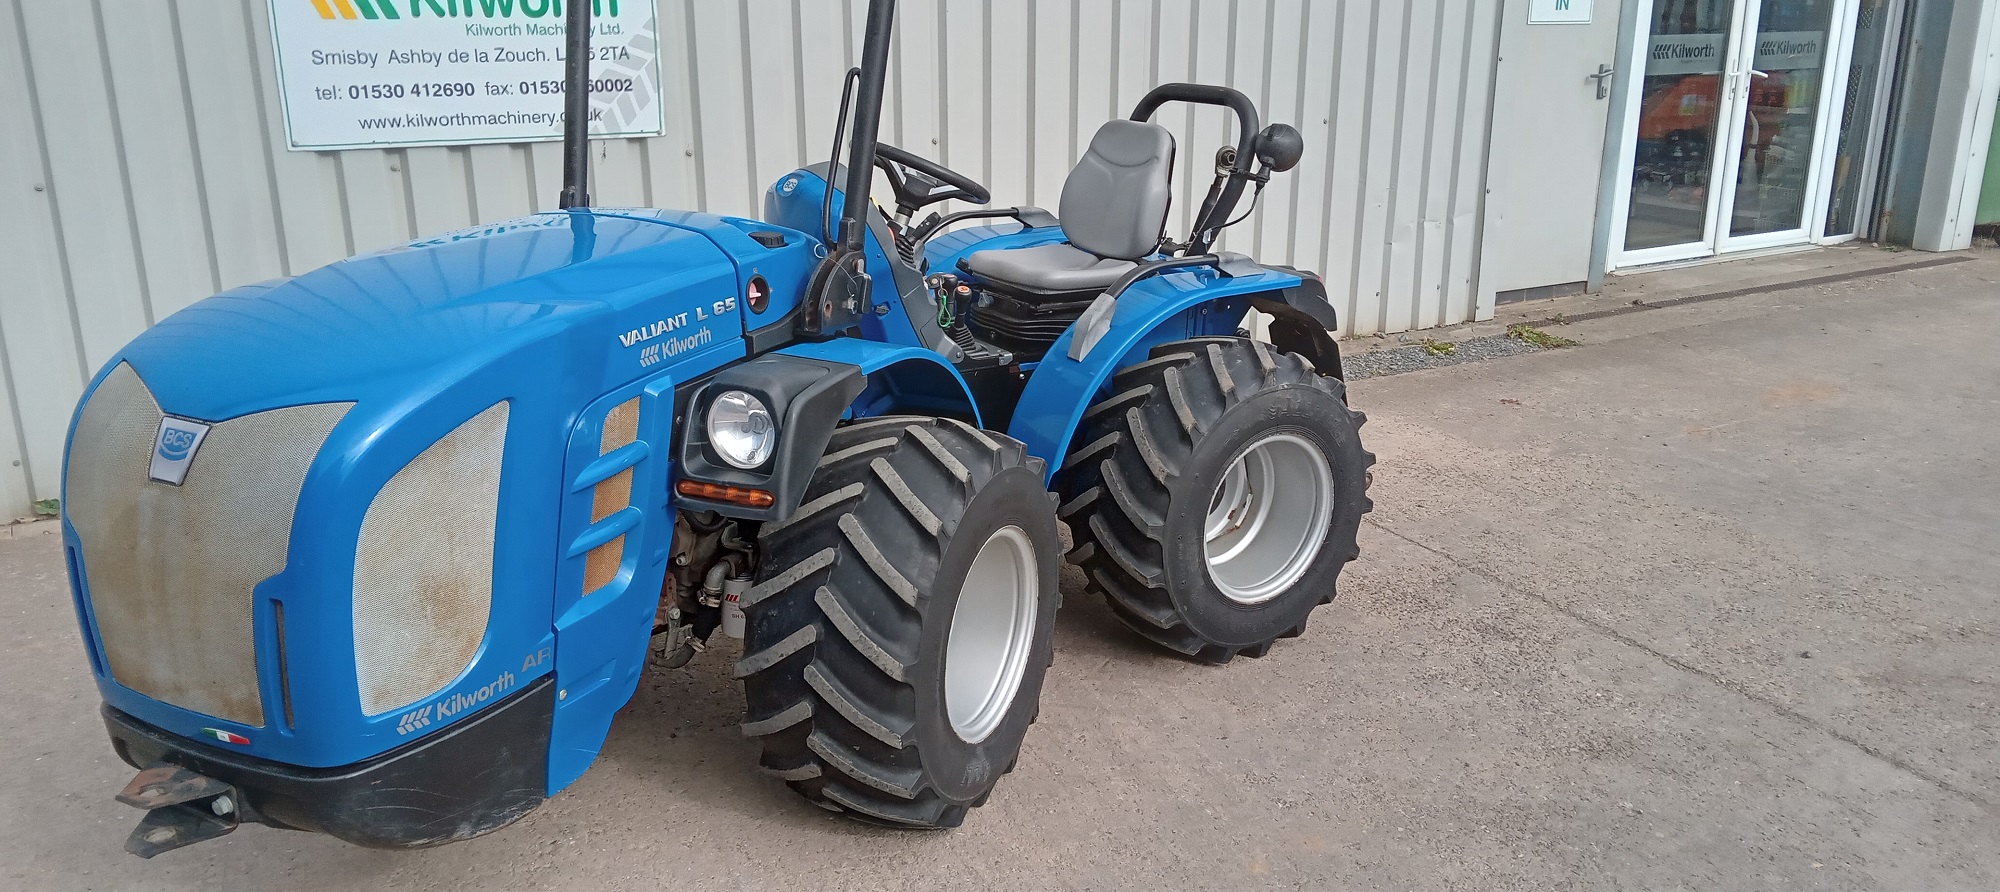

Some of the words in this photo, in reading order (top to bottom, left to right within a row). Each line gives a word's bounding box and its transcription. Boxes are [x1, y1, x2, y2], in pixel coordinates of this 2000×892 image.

[465, 23, 522, 37] Kilworth
[526, 23, 596, 39] Machiy
[311, 49, 378, 68] Smisby
[388, 49, 442, 67] Ashby
[448, 49, 470, 63] de
[474, 48, 490, 63] la
[493, 47, 550, 63] Zouch.
[599, 45, 630, 61] 2TA
[1671, 43, 1715, 58] Kilworth
[1776, 39, 1817, 54] Kilworth
[315, 85, 343, 100] tel:
[348, 84, 405, 99] 01530
[410, 82, 475, 98] 412690
[484, 81, 514, 96] fax:
[587, 78, 633, 93] 60002
[358, 108, 602, 130] www.kilworthmachinery.cuk
[618, 312, 688, 348] VALIANT
[695, 306, 709, 322] L
[712, 296, 736, 316] 65
[661, 325, 712, 360] Kilworth
[163, 429, 193, 449] BCS
[437, 670, 515, 721] Kilworth
